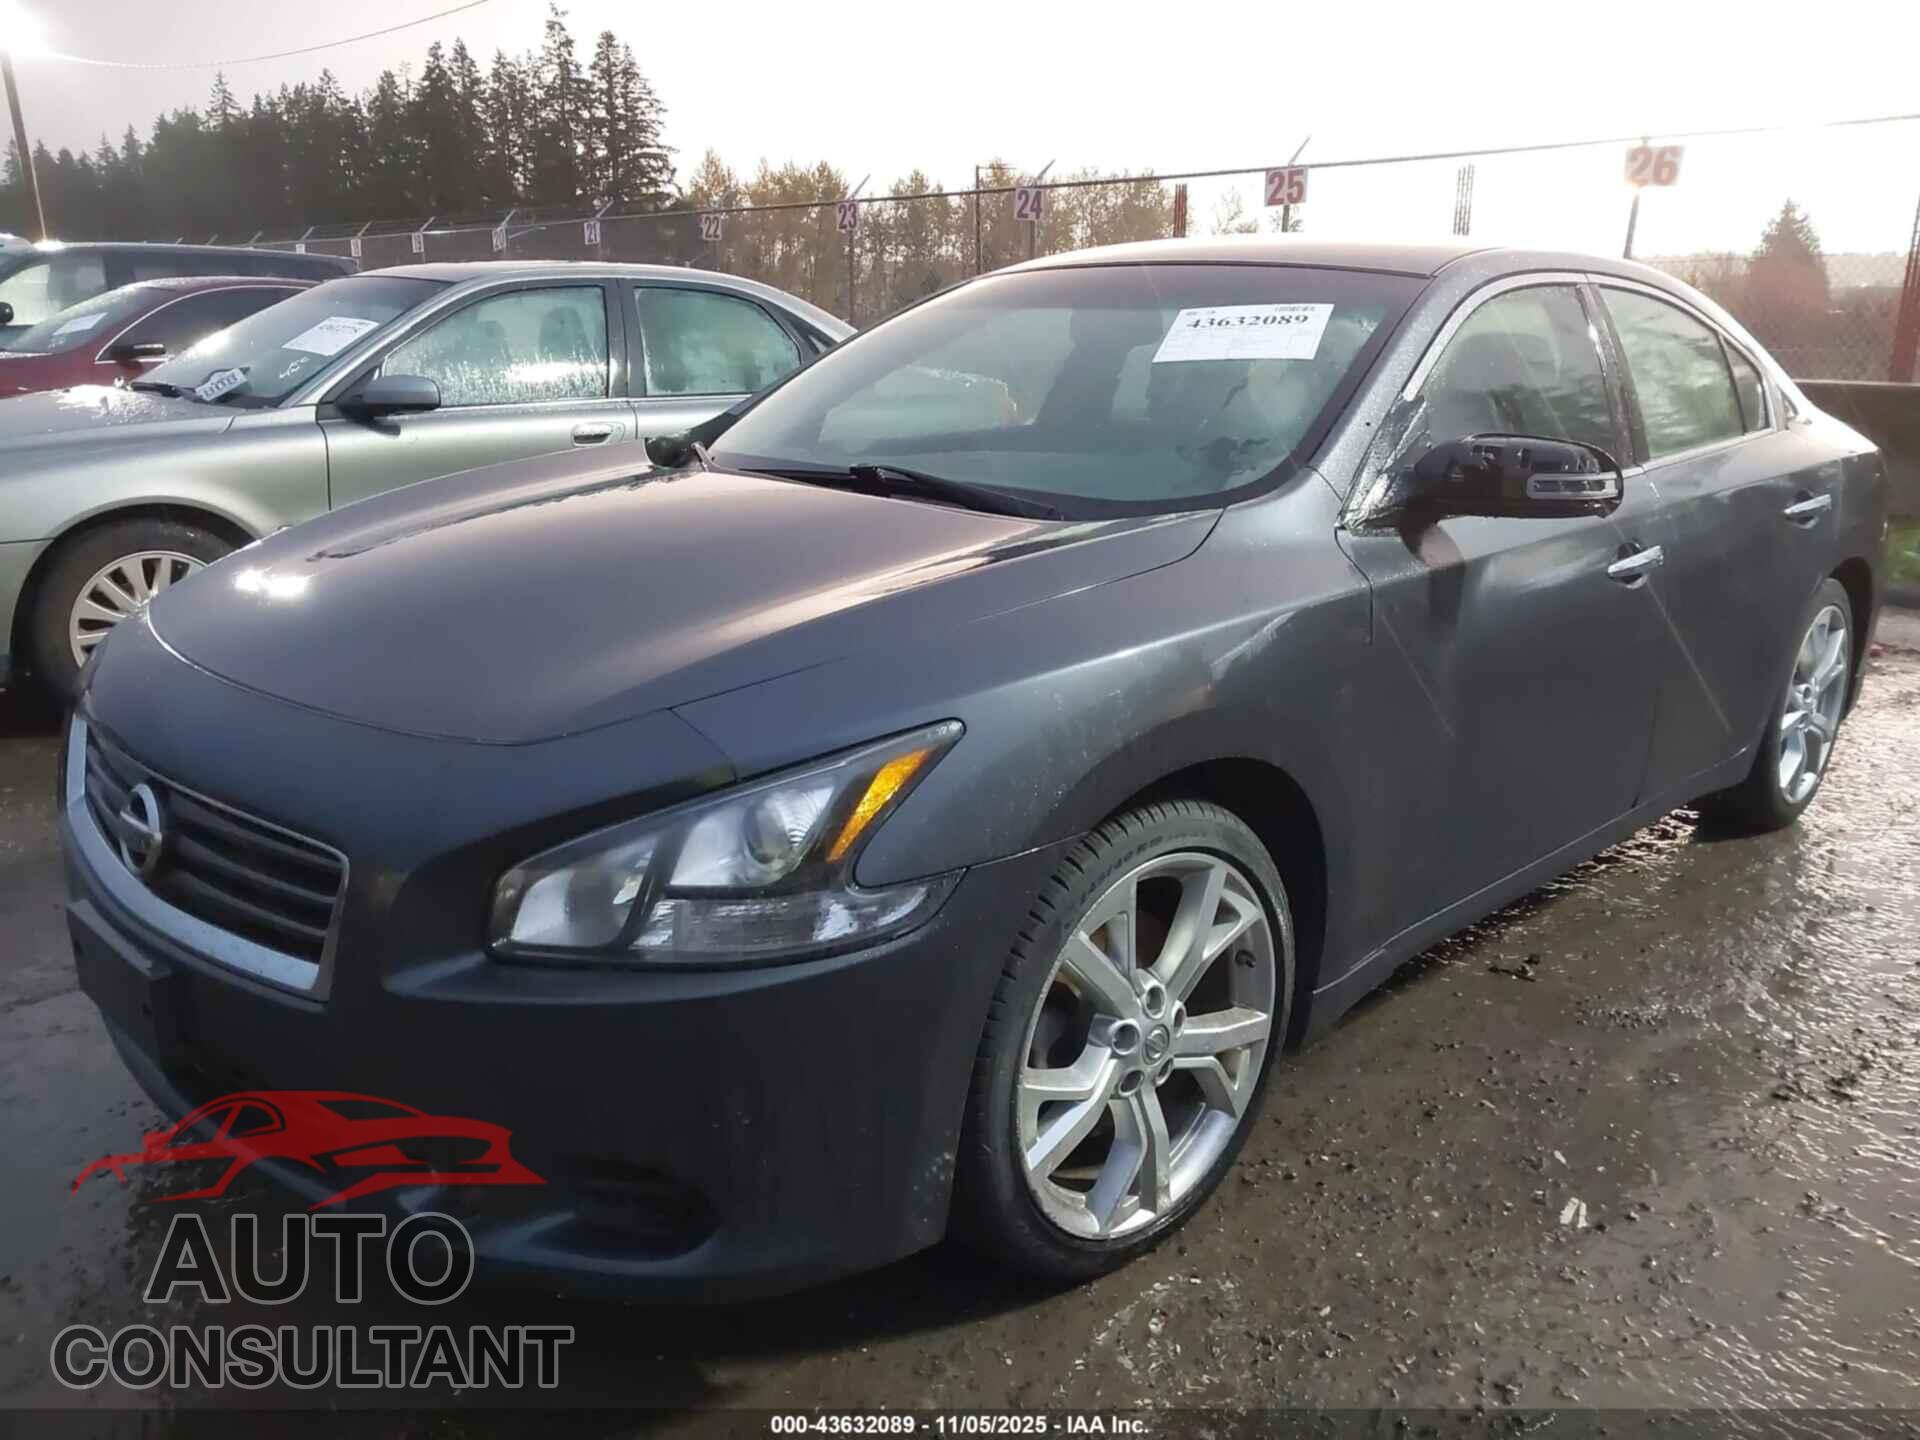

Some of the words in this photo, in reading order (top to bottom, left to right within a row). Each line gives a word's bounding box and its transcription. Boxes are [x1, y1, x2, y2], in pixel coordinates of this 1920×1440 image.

[1627, 147, 1678, 187] 26
[1268, 171, 1303, 205] 25
[838, 204, 857, 230] 23
[1016, 189, 1043, 219] 24
[587, 222, 599, 243] 21
[704, 216, 720, 239] 22
[1187, 315, 1309, 328] 43632089
